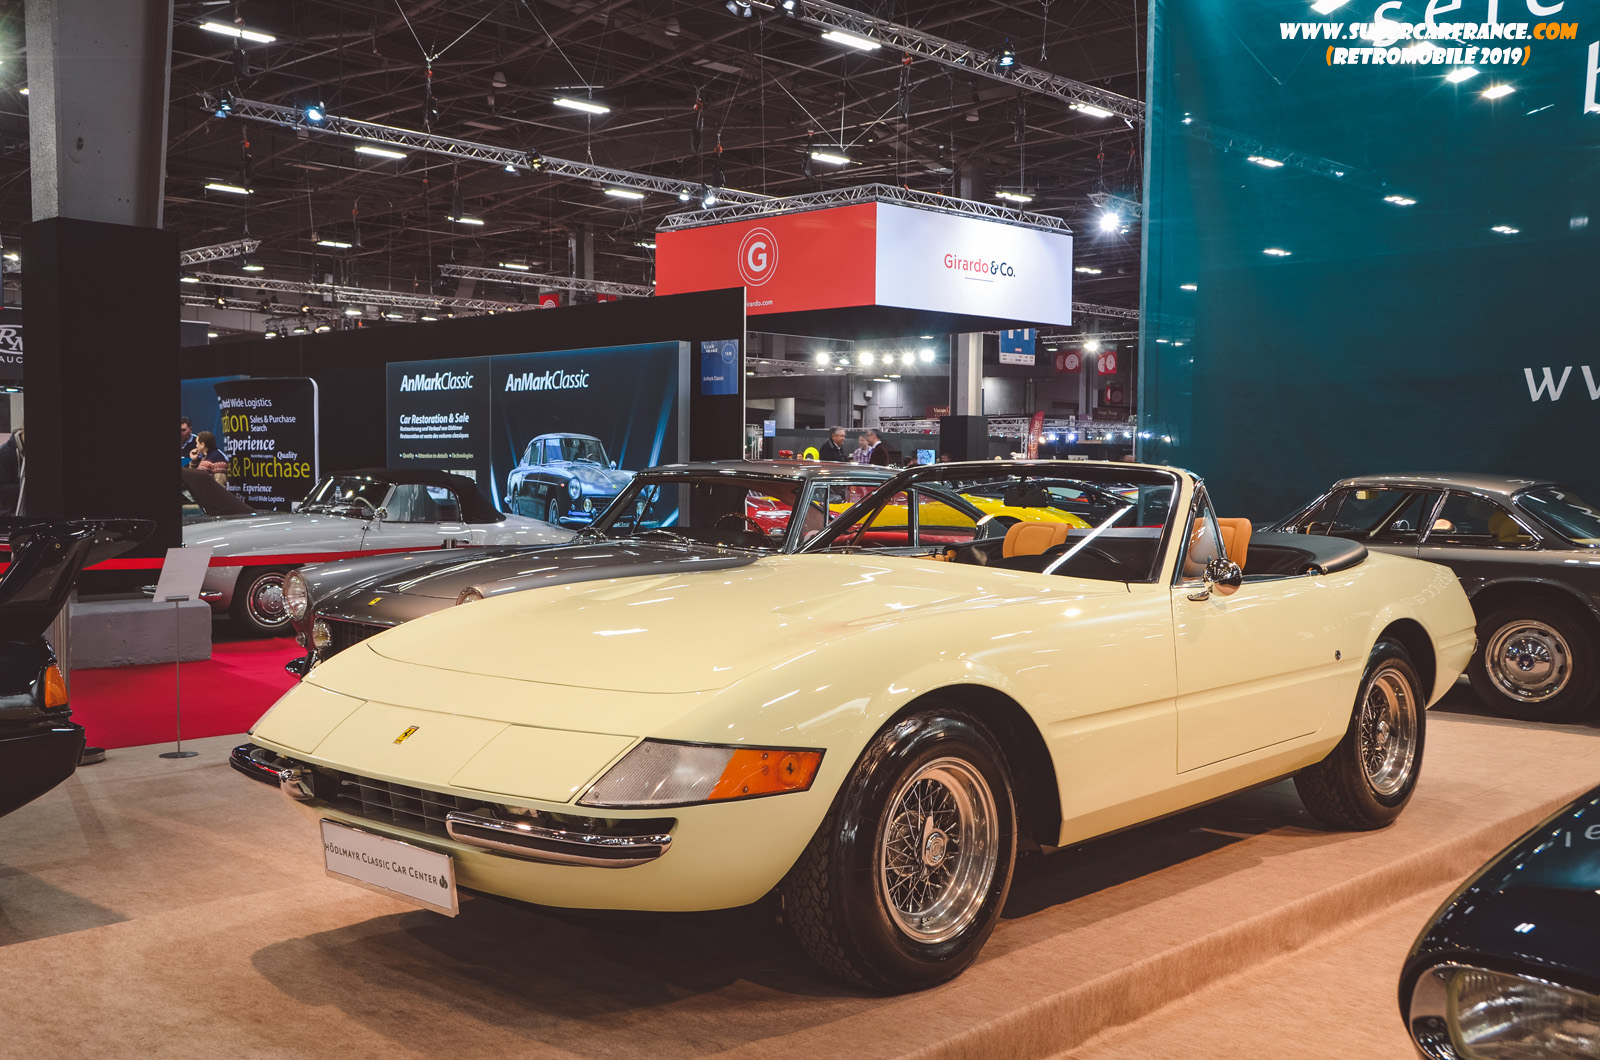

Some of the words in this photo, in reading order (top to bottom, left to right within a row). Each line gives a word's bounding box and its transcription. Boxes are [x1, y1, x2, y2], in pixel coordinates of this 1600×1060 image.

[748, 241, 767, 272] G
[400, 371, 474, 392] AnMarkClassic
[504, 369, 590, 392] AnMarkClassic
[230, 398, 244, 407] Wide
[244, 398, 272, 409] Logistics
[269, 415, 296, 423] Purchase
[400, 414, 411, 424] Car
[412, 414, 448, 424] Restoration
[448, 413, 454, 423] &
[455, 412, 469, 423] Sale
[277, 451, 298, 460] Quality
[232, 457, 240, 477] &
[243, 456, 310, 478] Purchase
[243, 484, 272, 494] Experience
